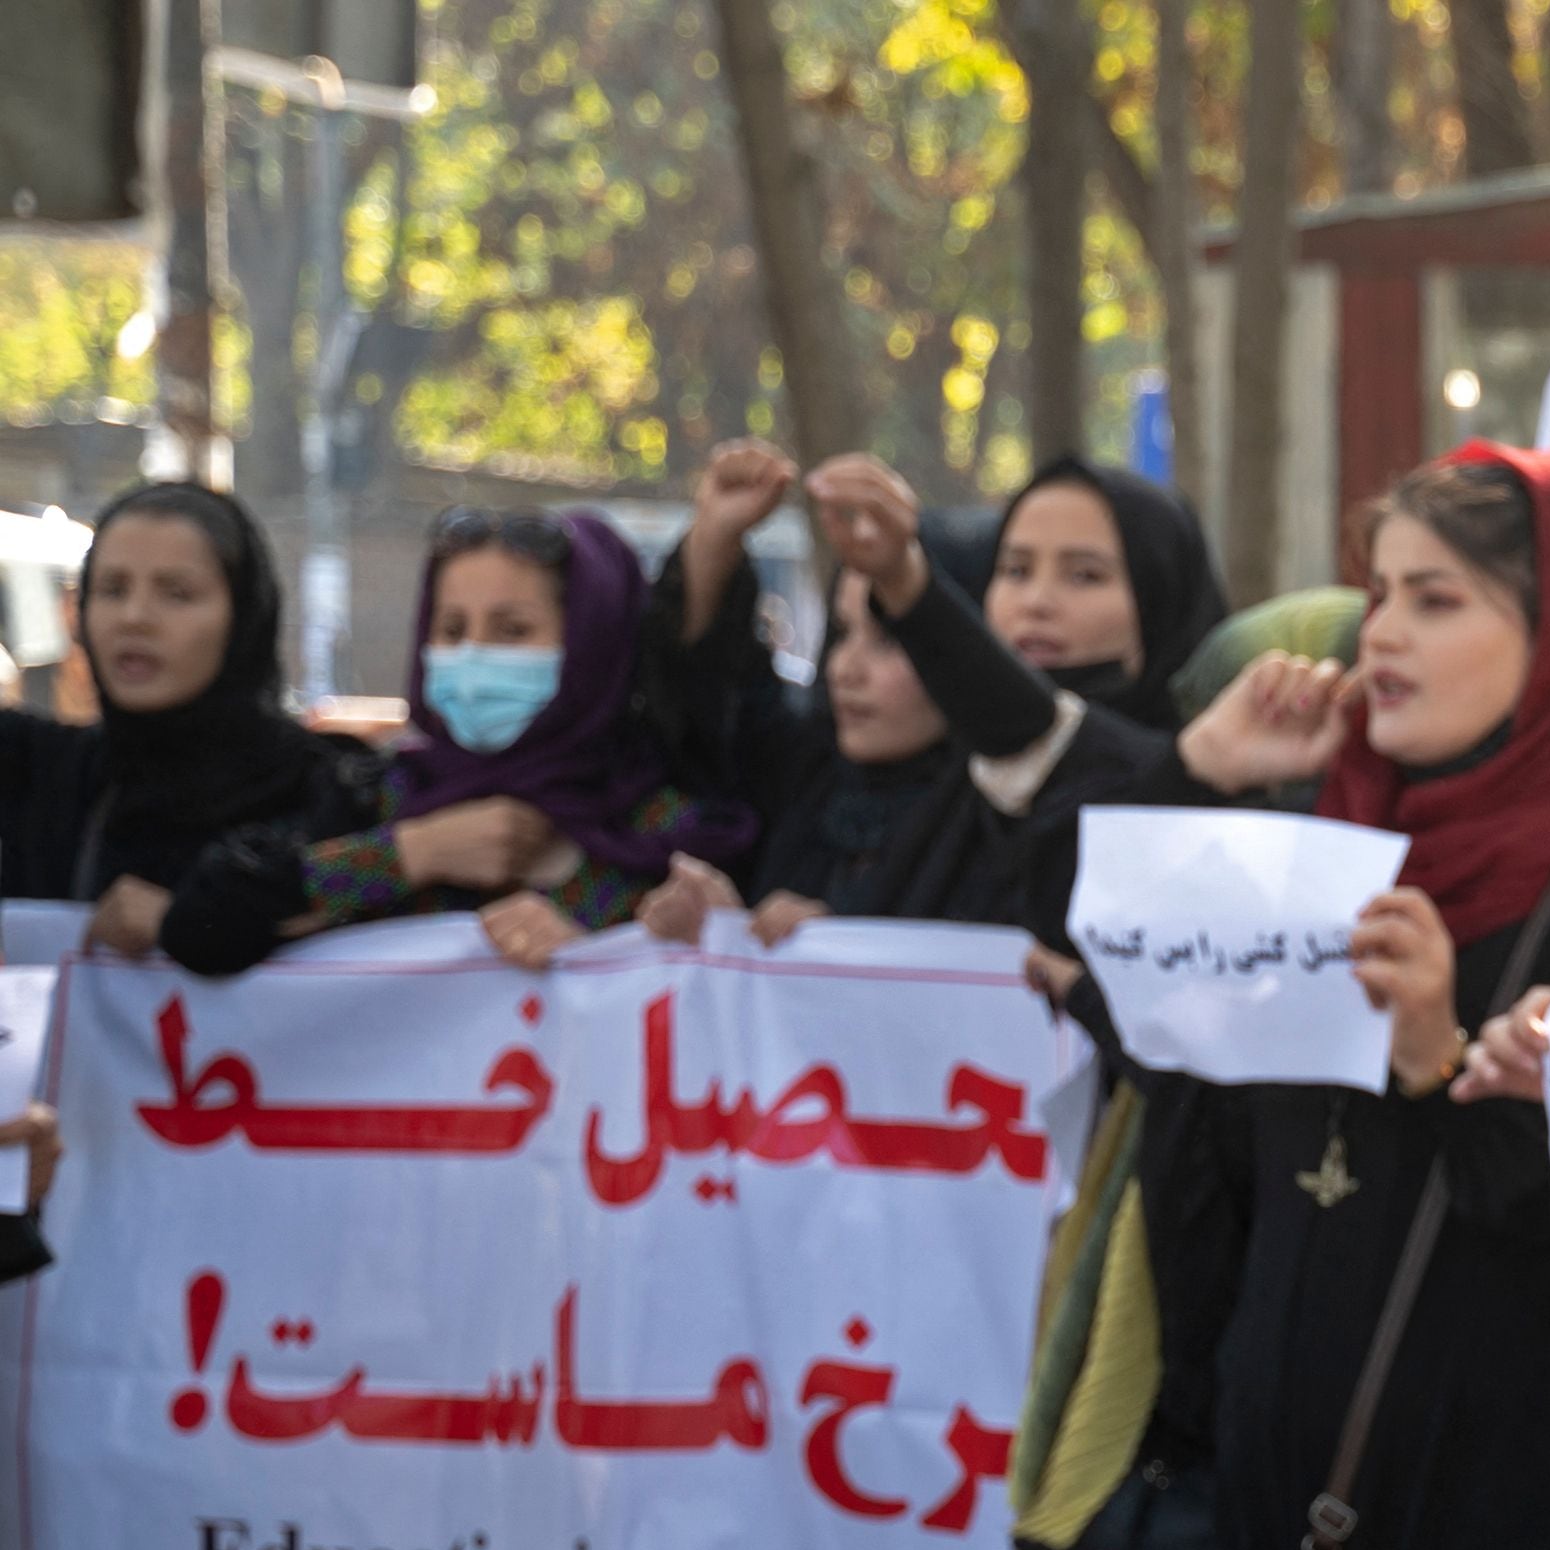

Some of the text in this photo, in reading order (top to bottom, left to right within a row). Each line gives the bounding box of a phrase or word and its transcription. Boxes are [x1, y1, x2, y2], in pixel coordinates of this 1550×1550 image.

[135, 989, 1048, 1208] حصیل خط
[799, 1313, 1017, 1535] رخ
